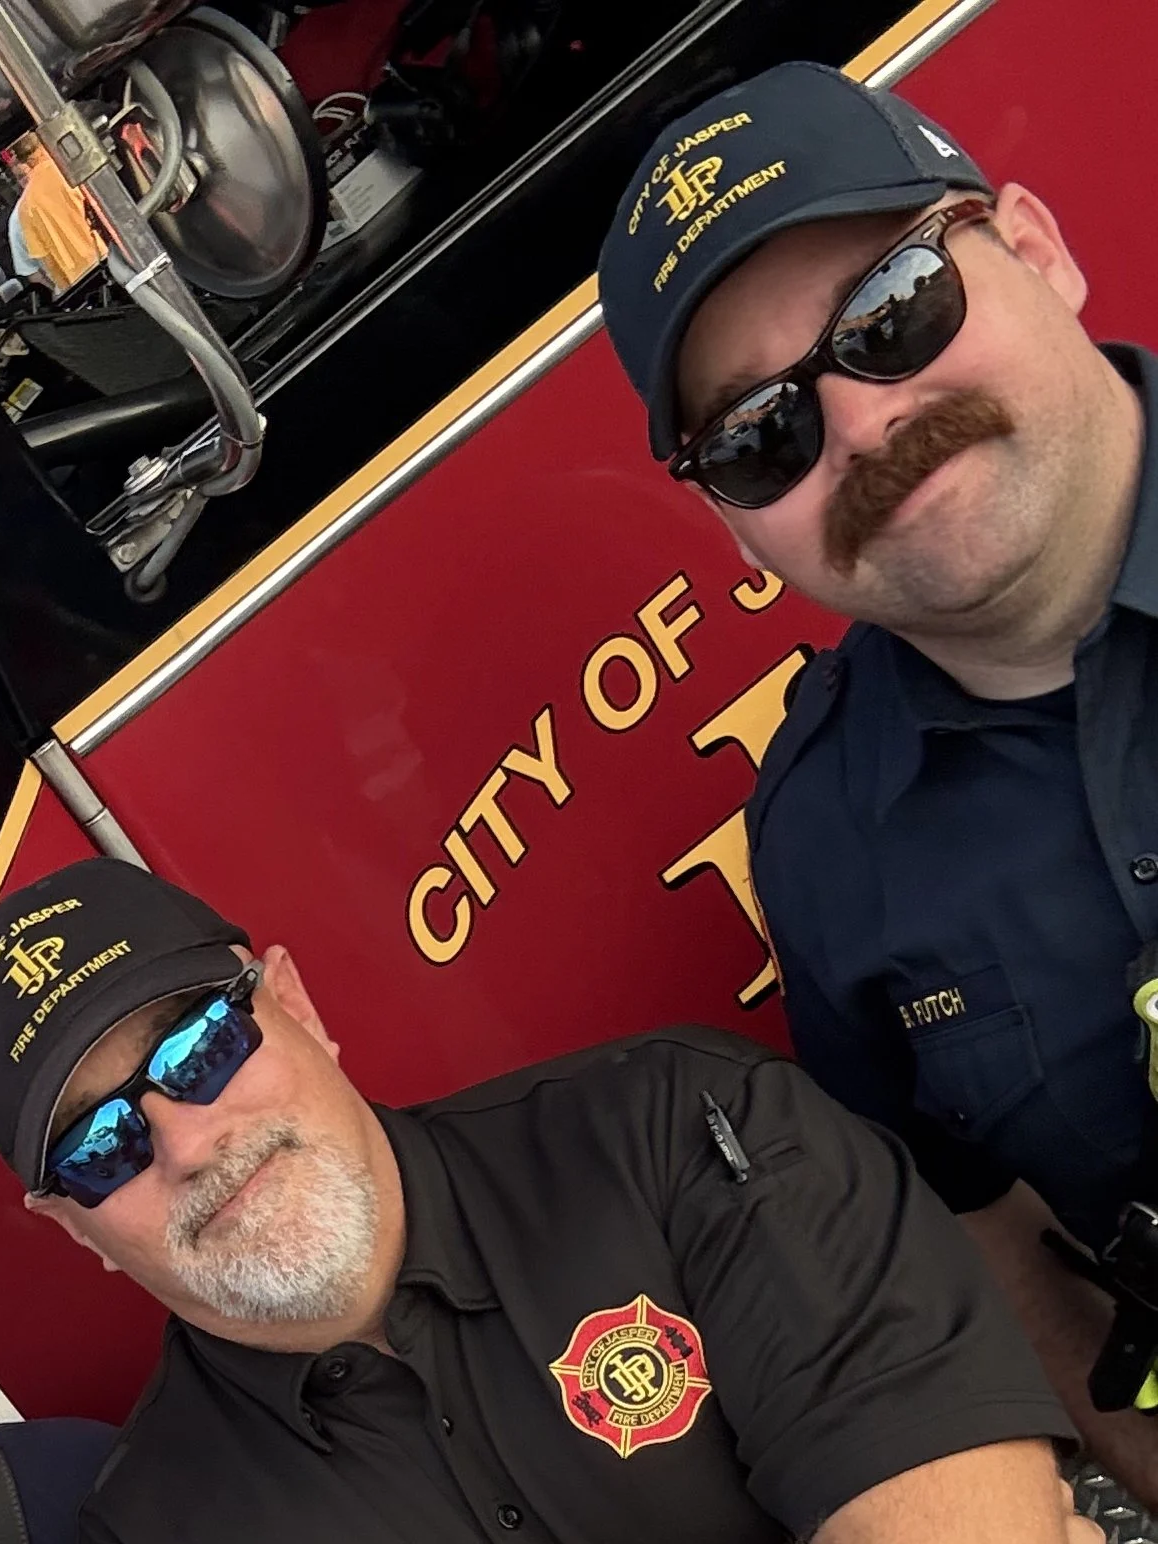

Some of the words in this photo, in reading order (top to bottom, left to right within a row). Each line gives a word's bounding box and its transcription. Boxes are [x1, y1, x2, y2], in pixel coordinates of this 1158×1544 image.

[628, 182, 650, 236] CITY
[651, 154, 671, 184] OF
[673, 112, 753, 158] JASPER
[653, 251, 679, 293] FIRE
[677, 160, 787, 253] DEPARTMENT
[405, 703, 575, 967] CITY
[581, 569, 705, 734] OF
[9, 898, 83, 937] JASPER
[9, 1022, 37, 1063] FIRE
[32, 939, 132, 1025] DEPARTMENT
[912, 987, 966, 1025] FUTCH
[583, 1355, 596, 1386] CITY
[592, 1339, 606, 1356] OF
[604, 1327, 655, 1347] JASPER
[611, 1411, 639, 1426] FIRE
[639, 1363, 685, 1425] DEPARTMENT
